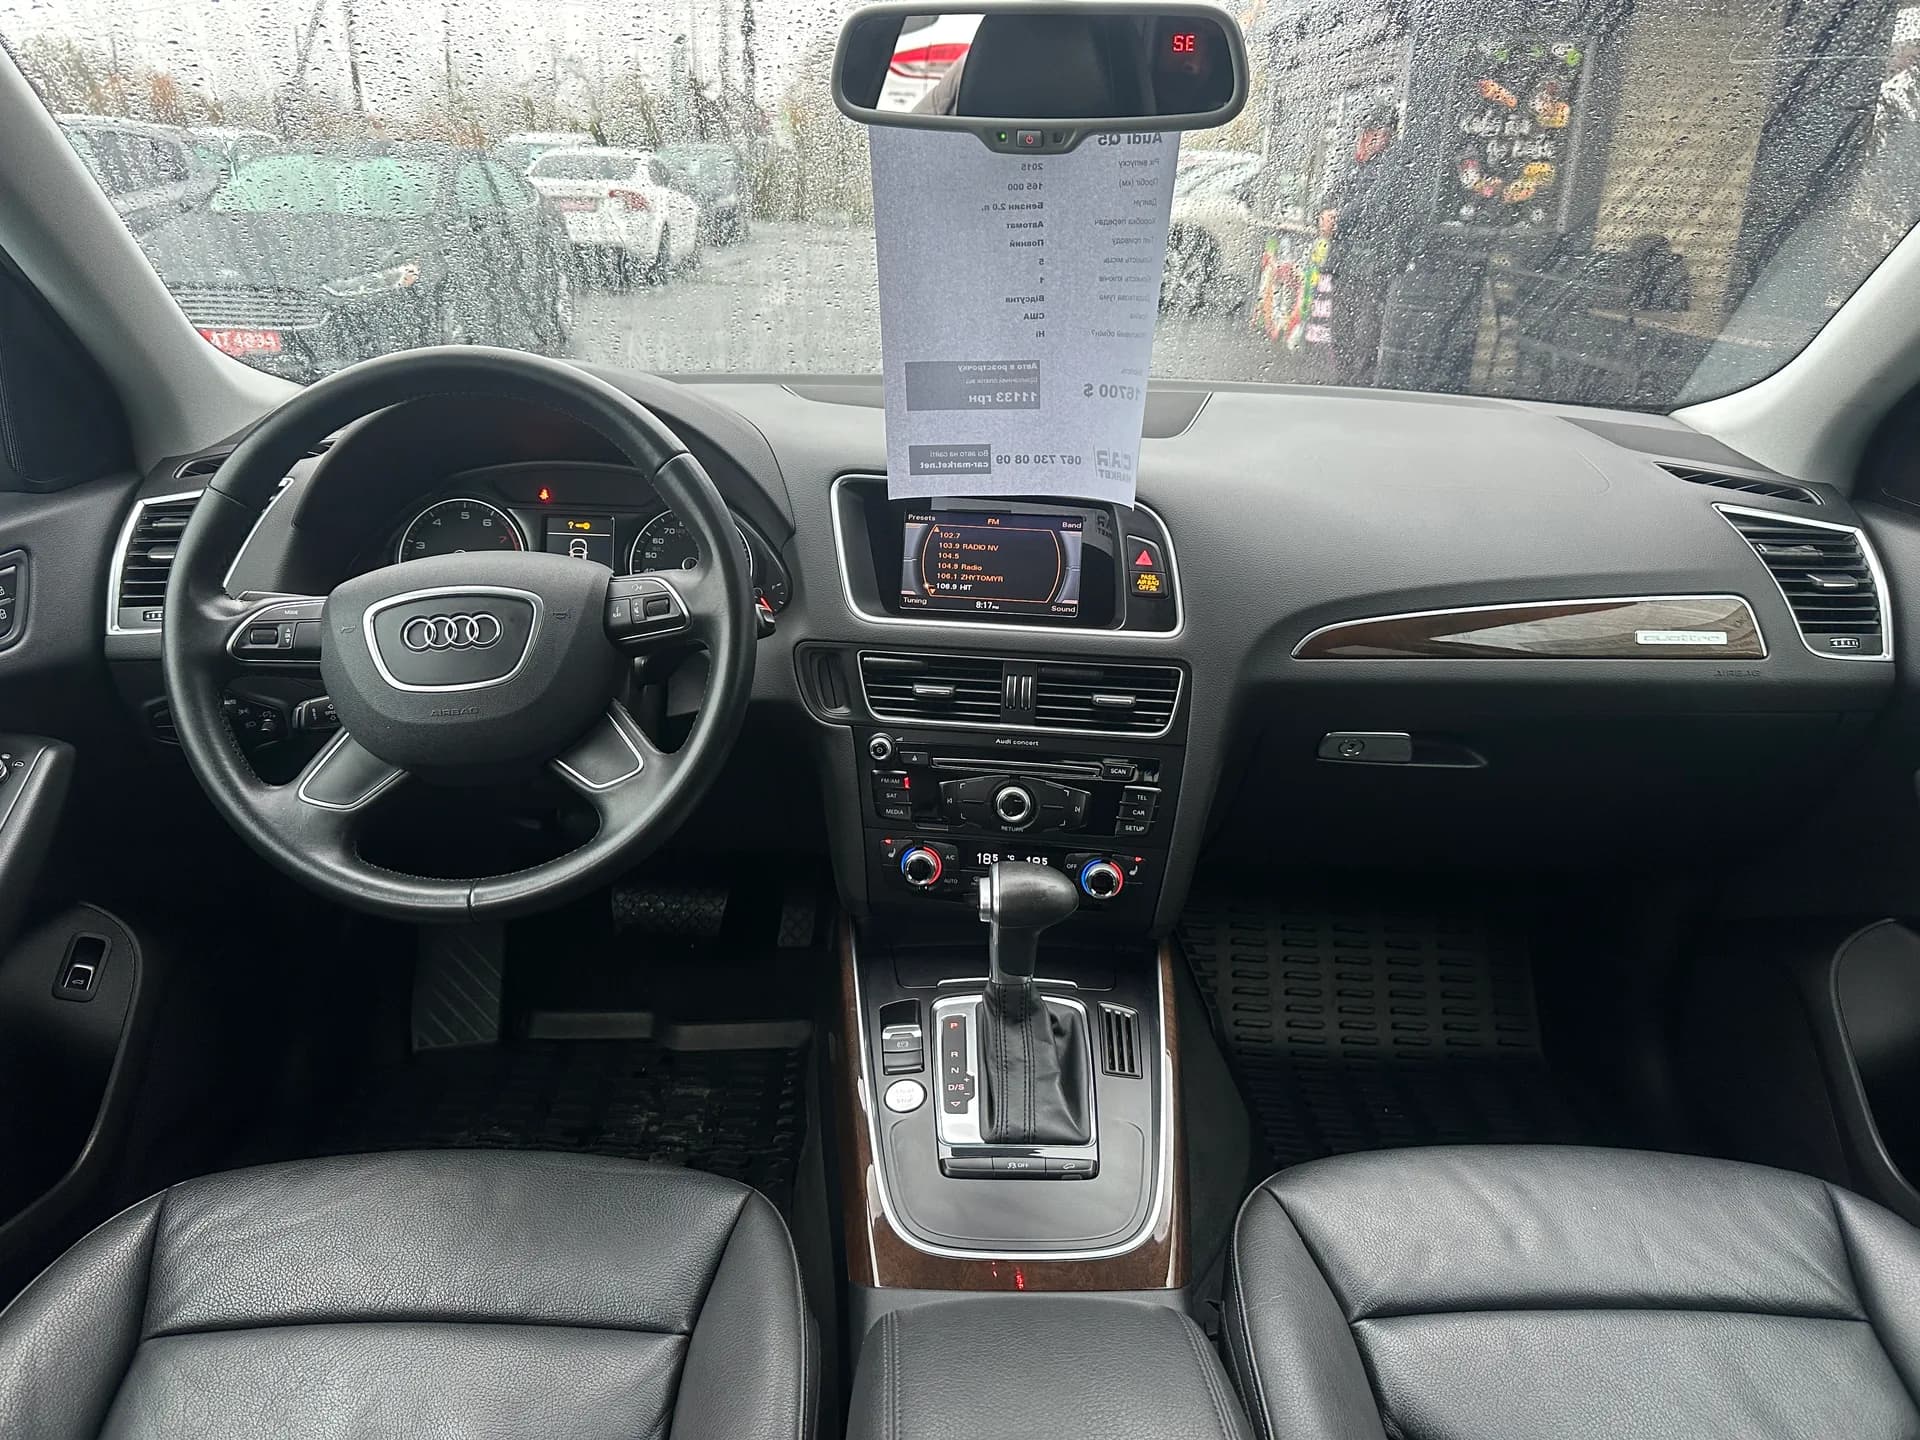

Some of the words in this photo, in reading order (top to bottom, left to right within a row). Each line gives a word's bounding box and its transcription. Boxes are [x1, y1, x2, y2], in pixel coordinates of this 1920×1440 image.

[1173, 35, 1195, 51] SE
[460, 511, 470, 520] 5
[908, 513, 936, 521] Presets
[432, 518, 441, 526] 4
[482, 519, 492, 527] 6
[1062, 521, 1082, 529] Band
[663, 527, 675, 535] 70
[415, 541, 426, 550] 3
[962, 543, 986, 551] RADIO
[987, 544, 999, 552] NV
[645, 551, 657, 559] 50
[938, 552, 960, 560] 104.5
[961, 563, 983, 571] Radio
[936, 572, 957, 580] 106.1
[960, 574, 1004, 583] ZHYTOMYR
[903, 597, 928, 605] Tuning
[1051, 605, 1076, 613] Sound
[1643, 634, 1720, 643] quattro
[1713, 669, 1761, 677] AIRBAG
[430, 706, 480, 717] AIRBAG
[1000, 825, 1024, 833] RETURN
[950, 1022, 958, 1030] P
[947, 1083, 965, 1091] D/S
